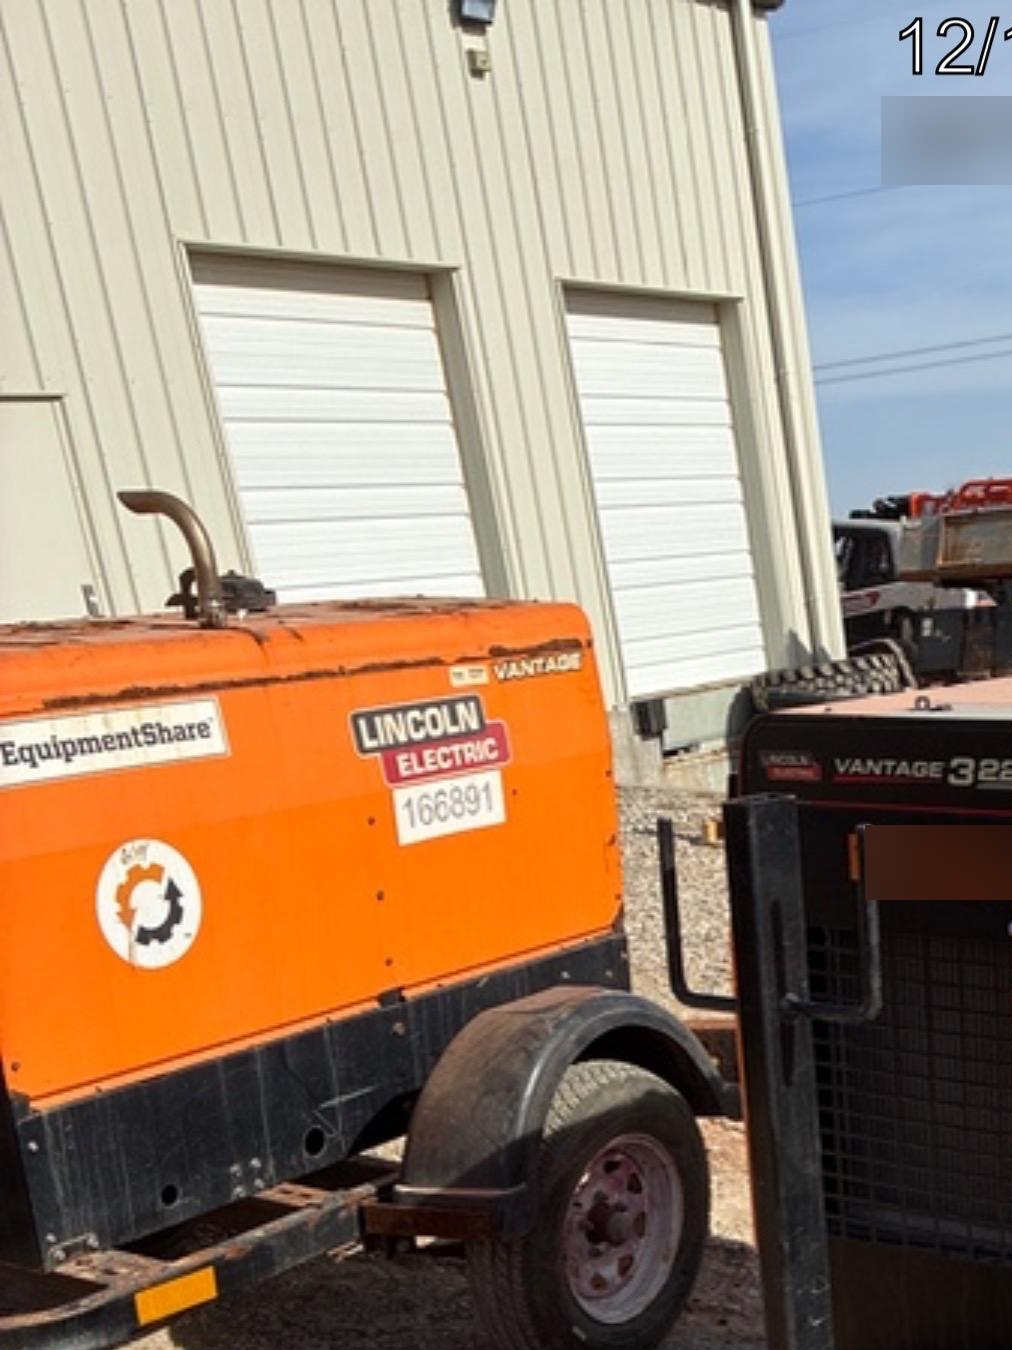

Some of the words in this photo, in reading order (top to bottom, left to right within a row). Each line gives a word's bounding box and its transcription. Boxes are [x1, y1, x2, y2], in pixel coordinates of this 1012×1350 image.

[493, 652, 582, 681] VANTAGE
[0, 720, 212, 768] EquipmentShare
[358, 700, 481, 749] LINCOLN
[395, 737, 500, 778] ELECTRIC
[834, 758, 944, 779] VANTAGE
[402, 780, 494, 829] 166891
